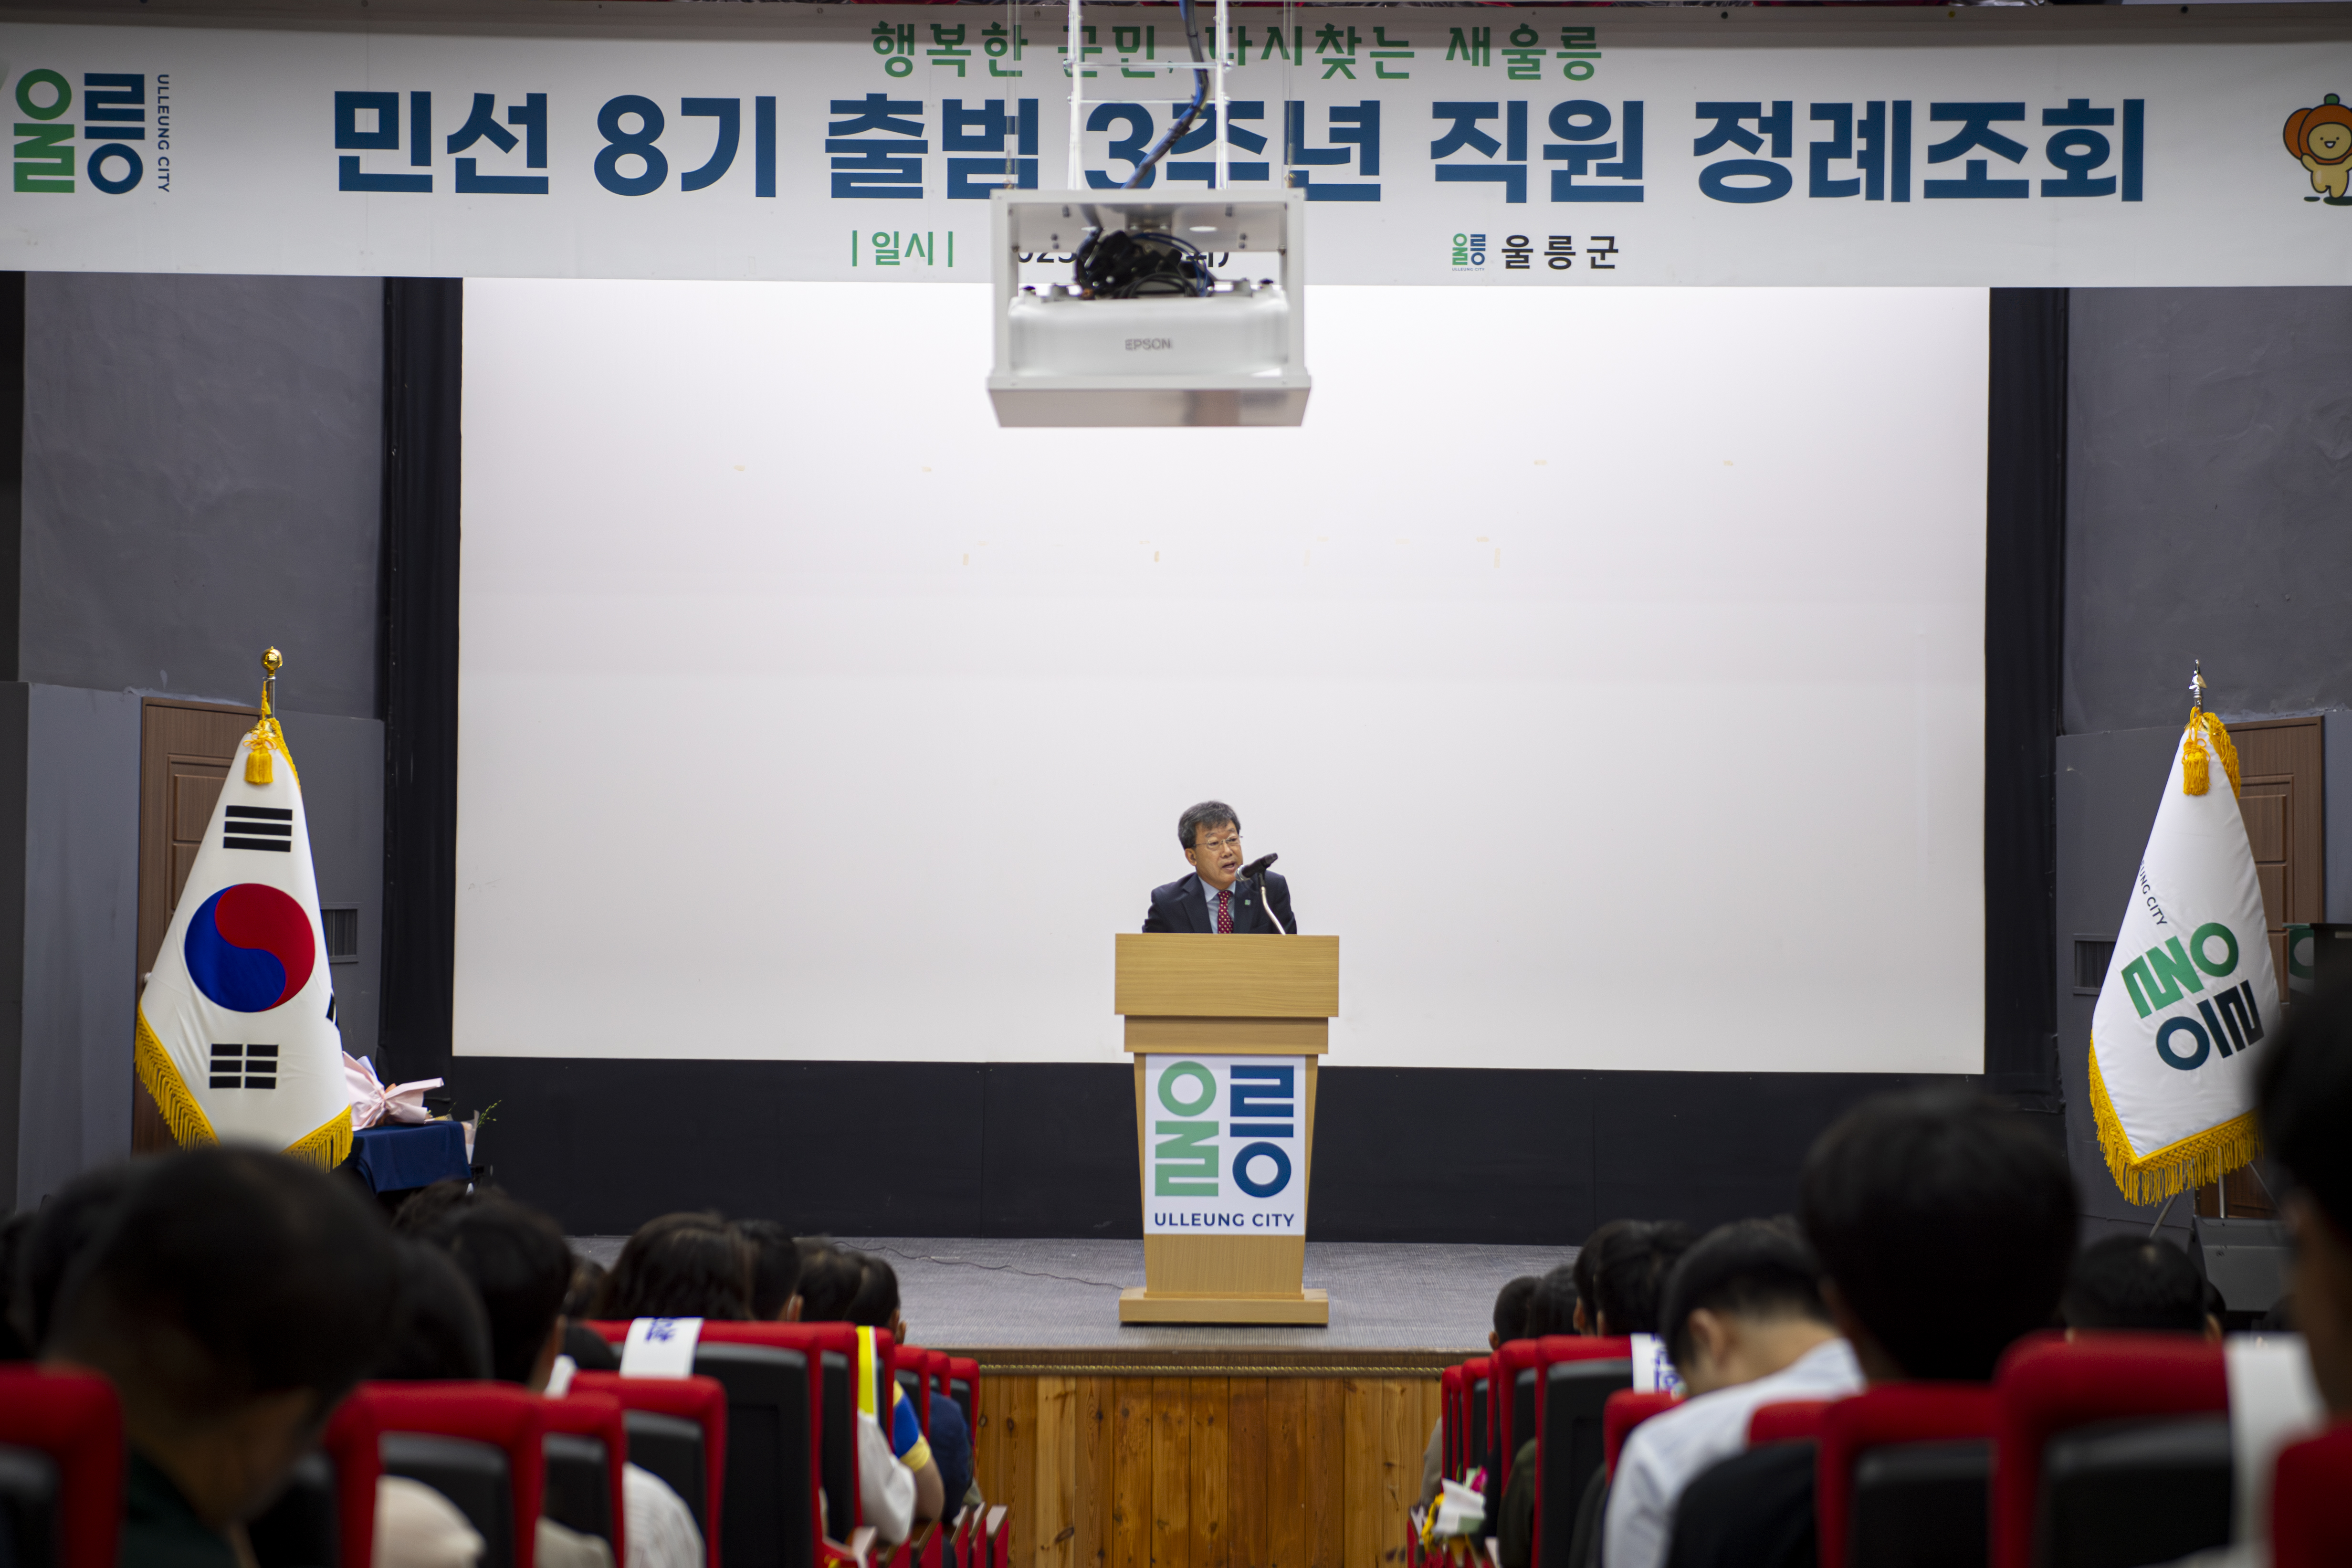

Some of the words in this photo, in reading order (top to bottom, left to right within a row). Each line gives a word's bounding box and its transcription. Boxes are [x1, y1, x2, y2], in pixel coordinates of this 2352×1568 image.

[871, 21, 1028, 77] 행복한
[1205, 23, 1415, 80] 다시찾는
[1445, 23, 1602, 81] 새울릉
[158, 74, 169, 150] ULLEUNG
[334, 91, 549, 195] 민선
[593, 94, 777, 198] 8기
[825, 93, 1038, 199] 출범
[1084, 95, 1381, 201] 3주년
[1431, 100, 1644, 203] 직원
[1693, 98, 2145, 203] 정례조회
[158, 157, 169, 192] CITY
[1502, 234, 1618, 270] 울릉군
[1125, 338, 1171, 350] EPSON
[2147, 897, 2167, 925] CITY
[1155, 1213, 1244, 1226] ULLEUNG
[1252, 1214, 1294, 1227] CITY
